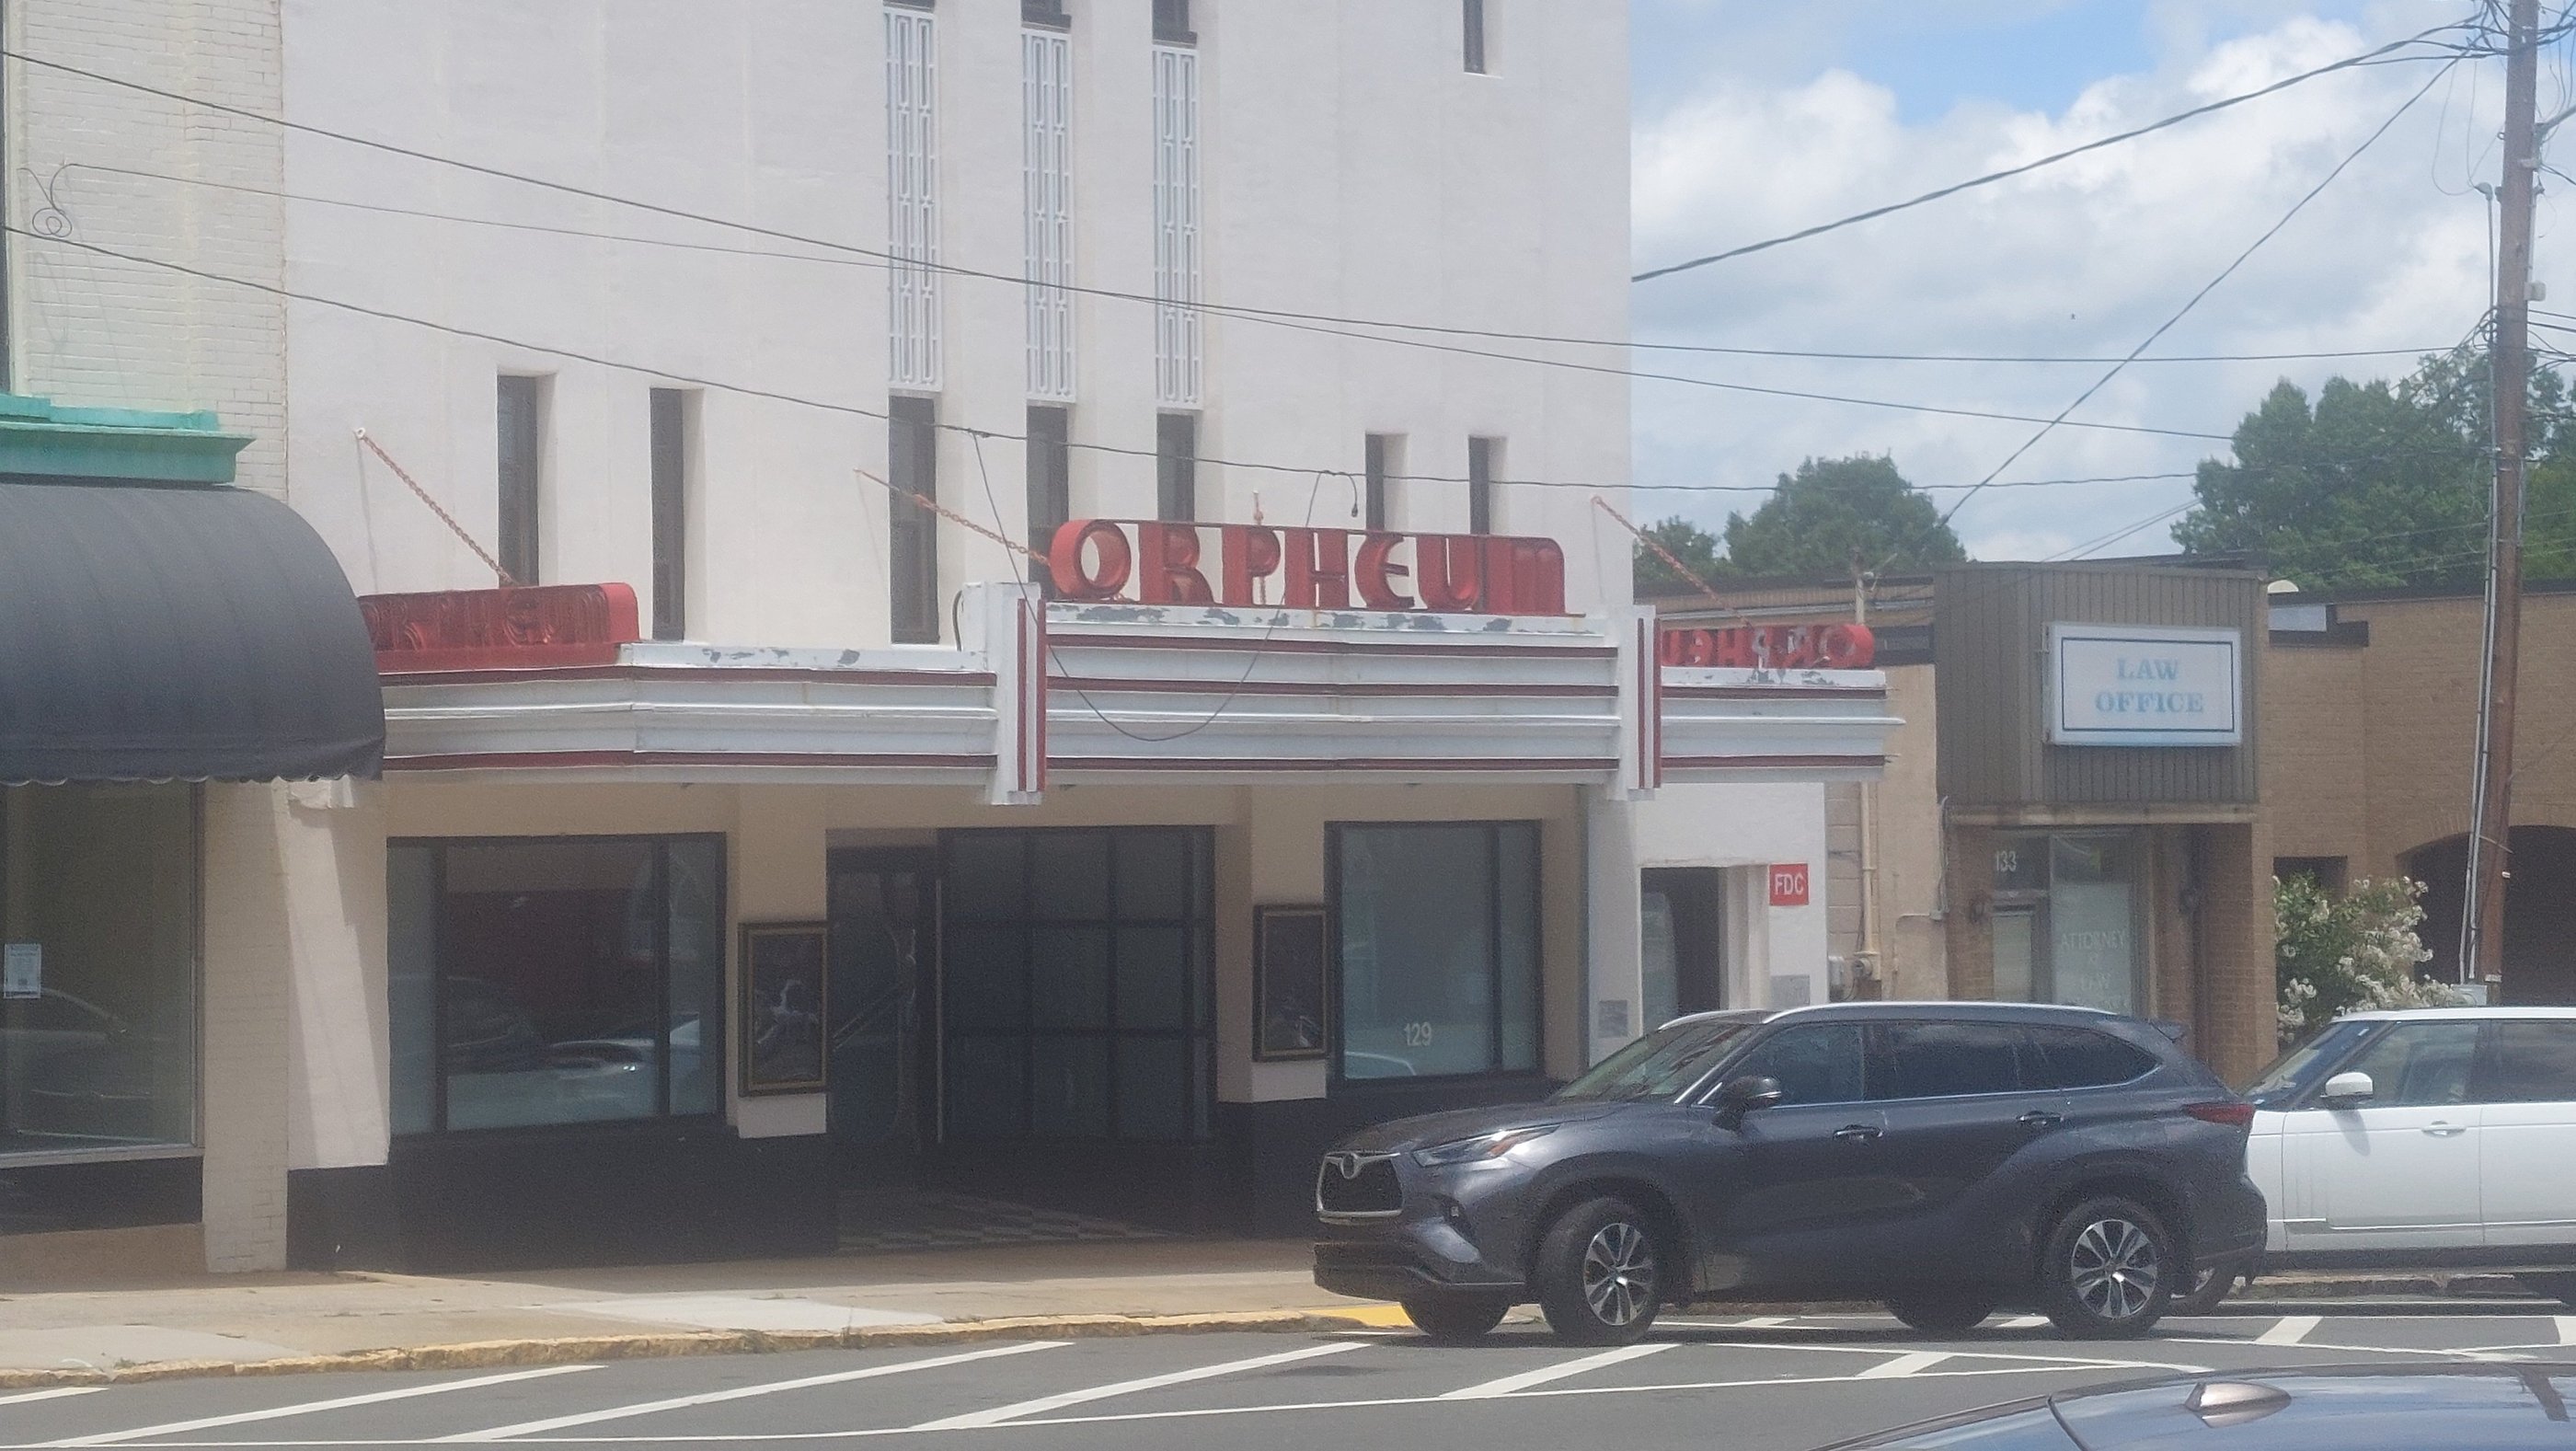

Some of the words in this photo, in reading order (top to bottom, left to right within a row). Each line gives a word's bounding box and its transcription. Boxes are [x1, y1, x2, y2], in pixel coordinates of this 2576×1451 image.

[1050, 519, 1565, 616] ORPHEUM
[2116, 657, 2179, 680] LAW
[2095, 691, 2203, 713] OFFICE
[1996, 850, 2018, 872] 133
[1775, 873, 1804, 895] FDC
[1404, 1021, 1432, 1046] 129
